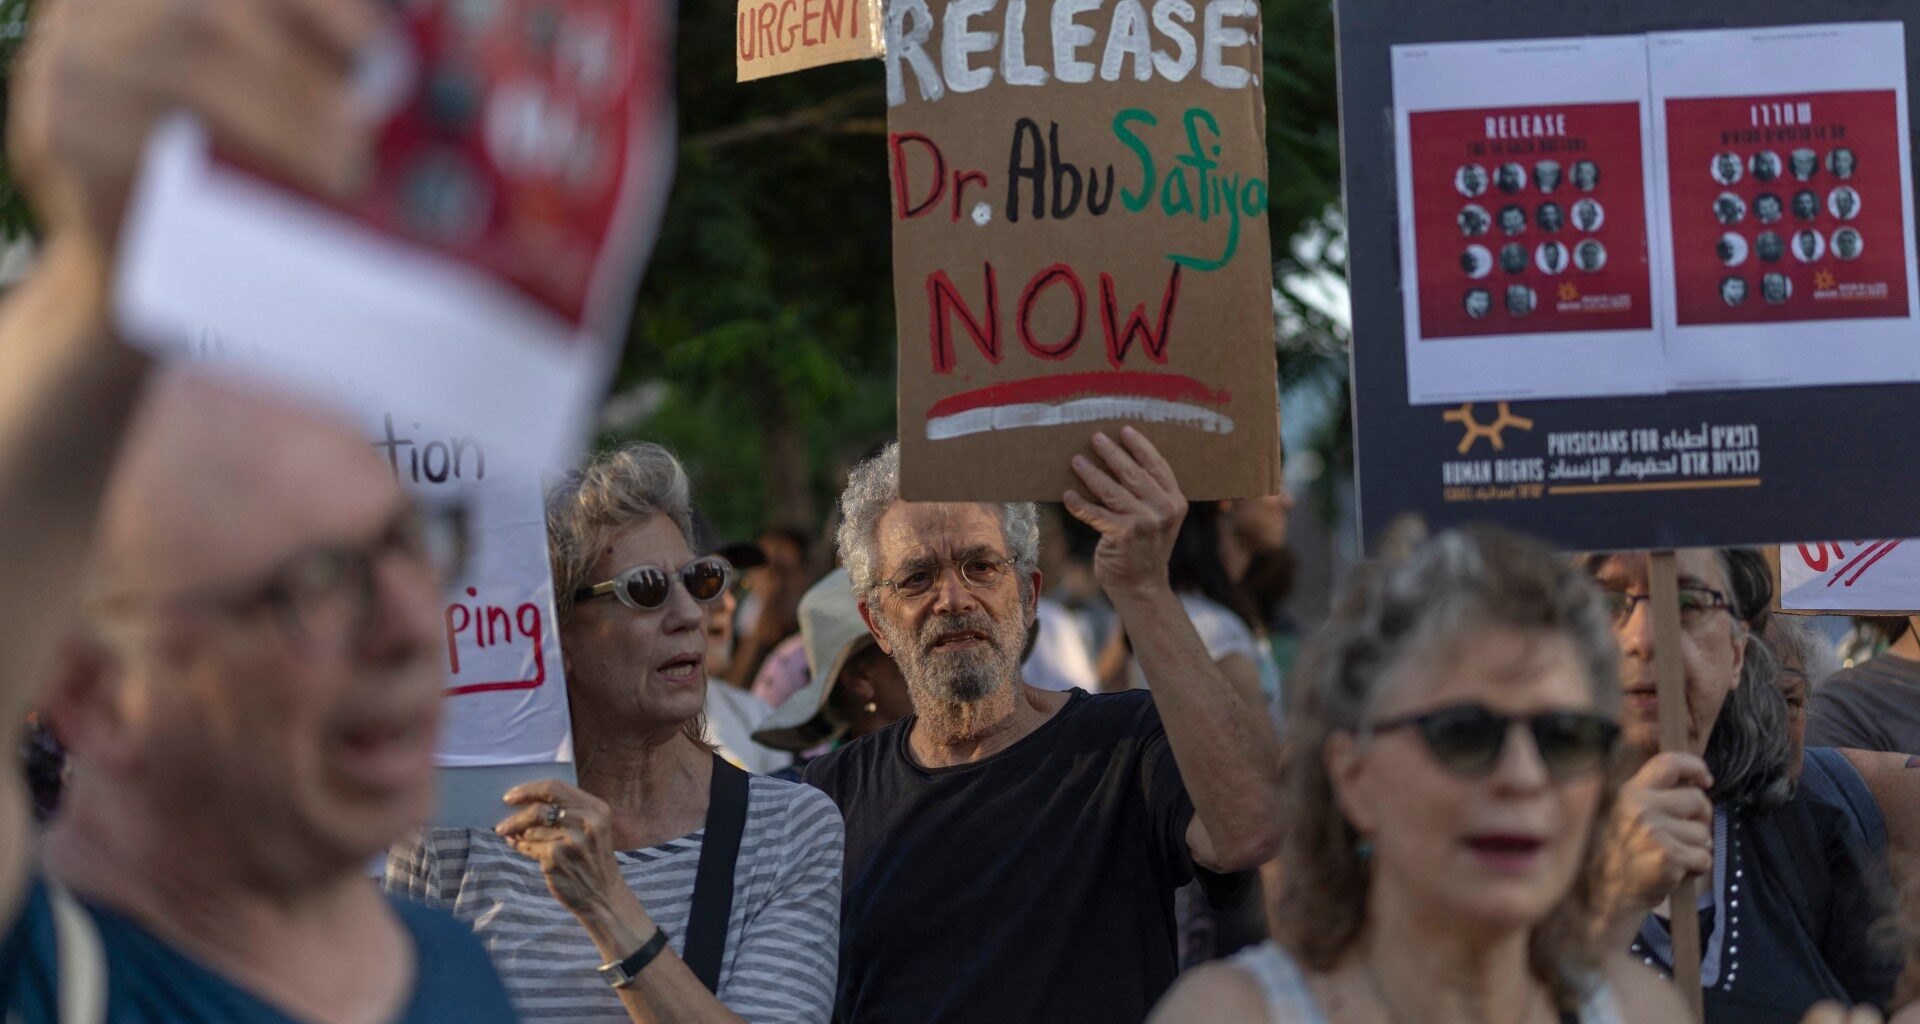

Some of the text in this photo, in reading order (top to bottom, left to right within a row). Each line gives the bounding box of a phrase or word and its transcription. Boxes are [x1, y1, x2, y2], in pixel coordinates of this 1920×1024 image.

[739, 0, 863, 61] URGENT
[886, 0, 1259, 107] RELEASE
[1485, 112, 1566, 139] RELEASE
[890, 108, 1268, 271] Dr. Abu Safiya
[926, 259, 1181, 374] NOW
[371, 411, 486, 485] tion
[1442, 457, 1545, 485] HUMAN RIGHTS
[1547, 428, 1660, 456] PHYSICIANS FOR
[443, 586, 546, 695] ping
